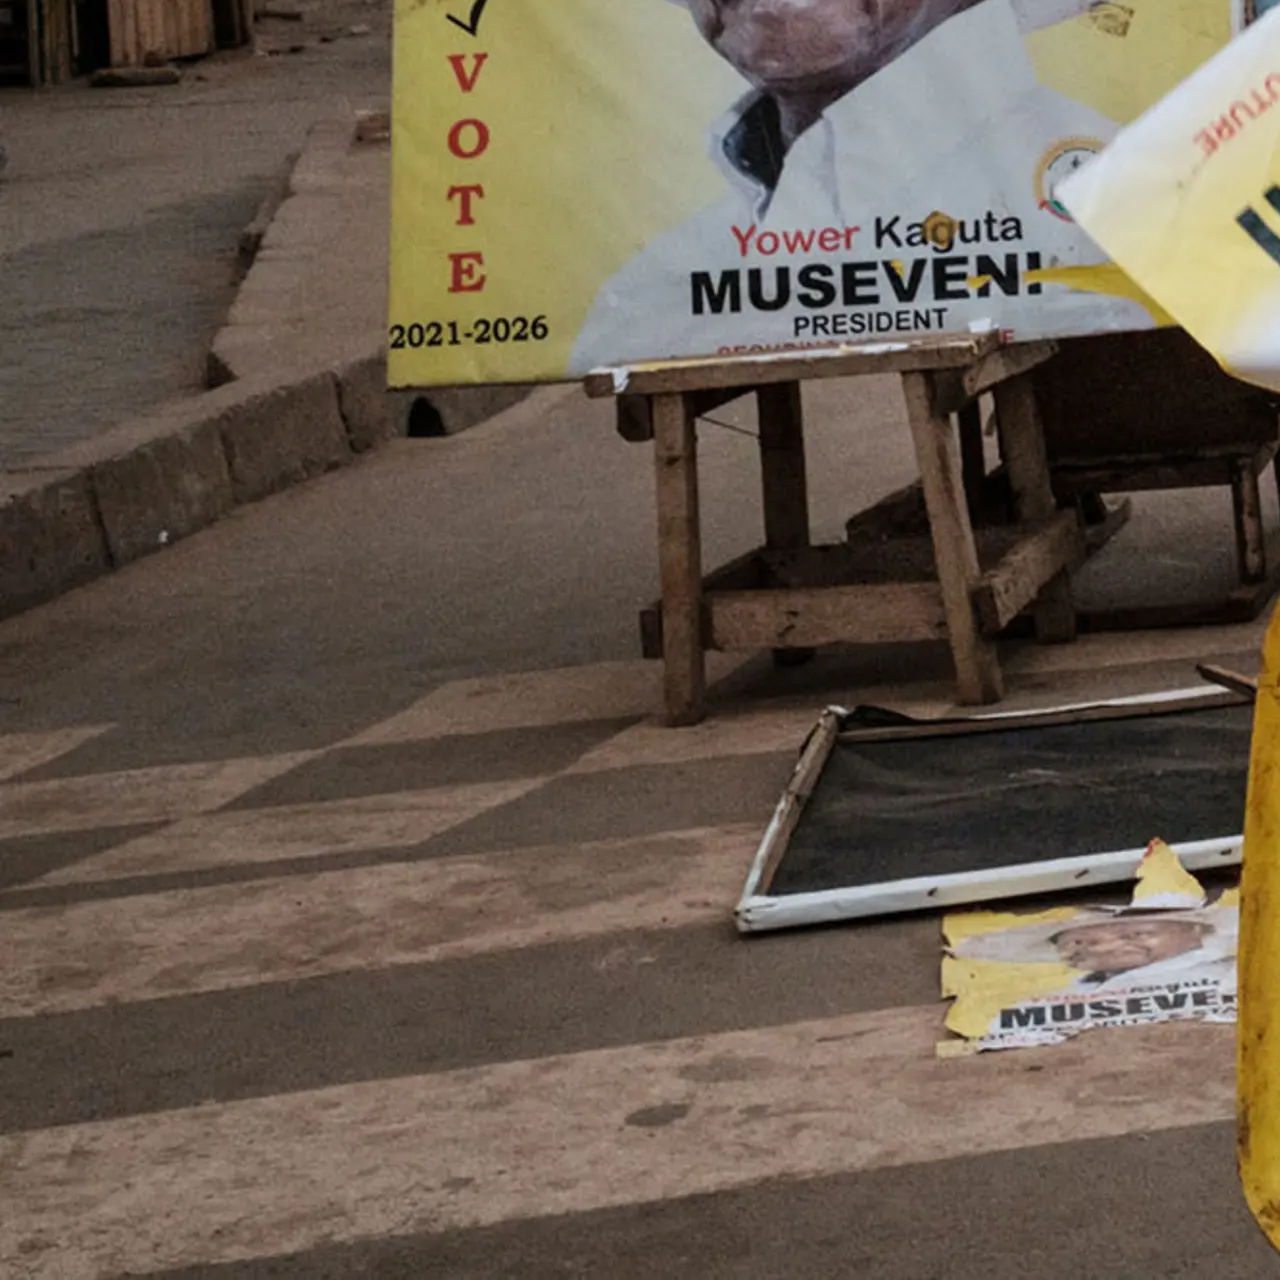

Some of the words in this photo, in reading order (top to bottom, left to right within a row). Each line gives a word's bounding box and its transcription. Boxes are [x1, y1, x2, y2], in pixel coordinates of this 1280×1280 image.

[446, 53, 491, 294] VOTE
[874, 211, 1023, 254] Kaguta
[690, 252, 1043, 315] MUSEVENI
[390, 316, 549, 349] 2021-2026
[793, 308, 948, 337] PRESIDENT
